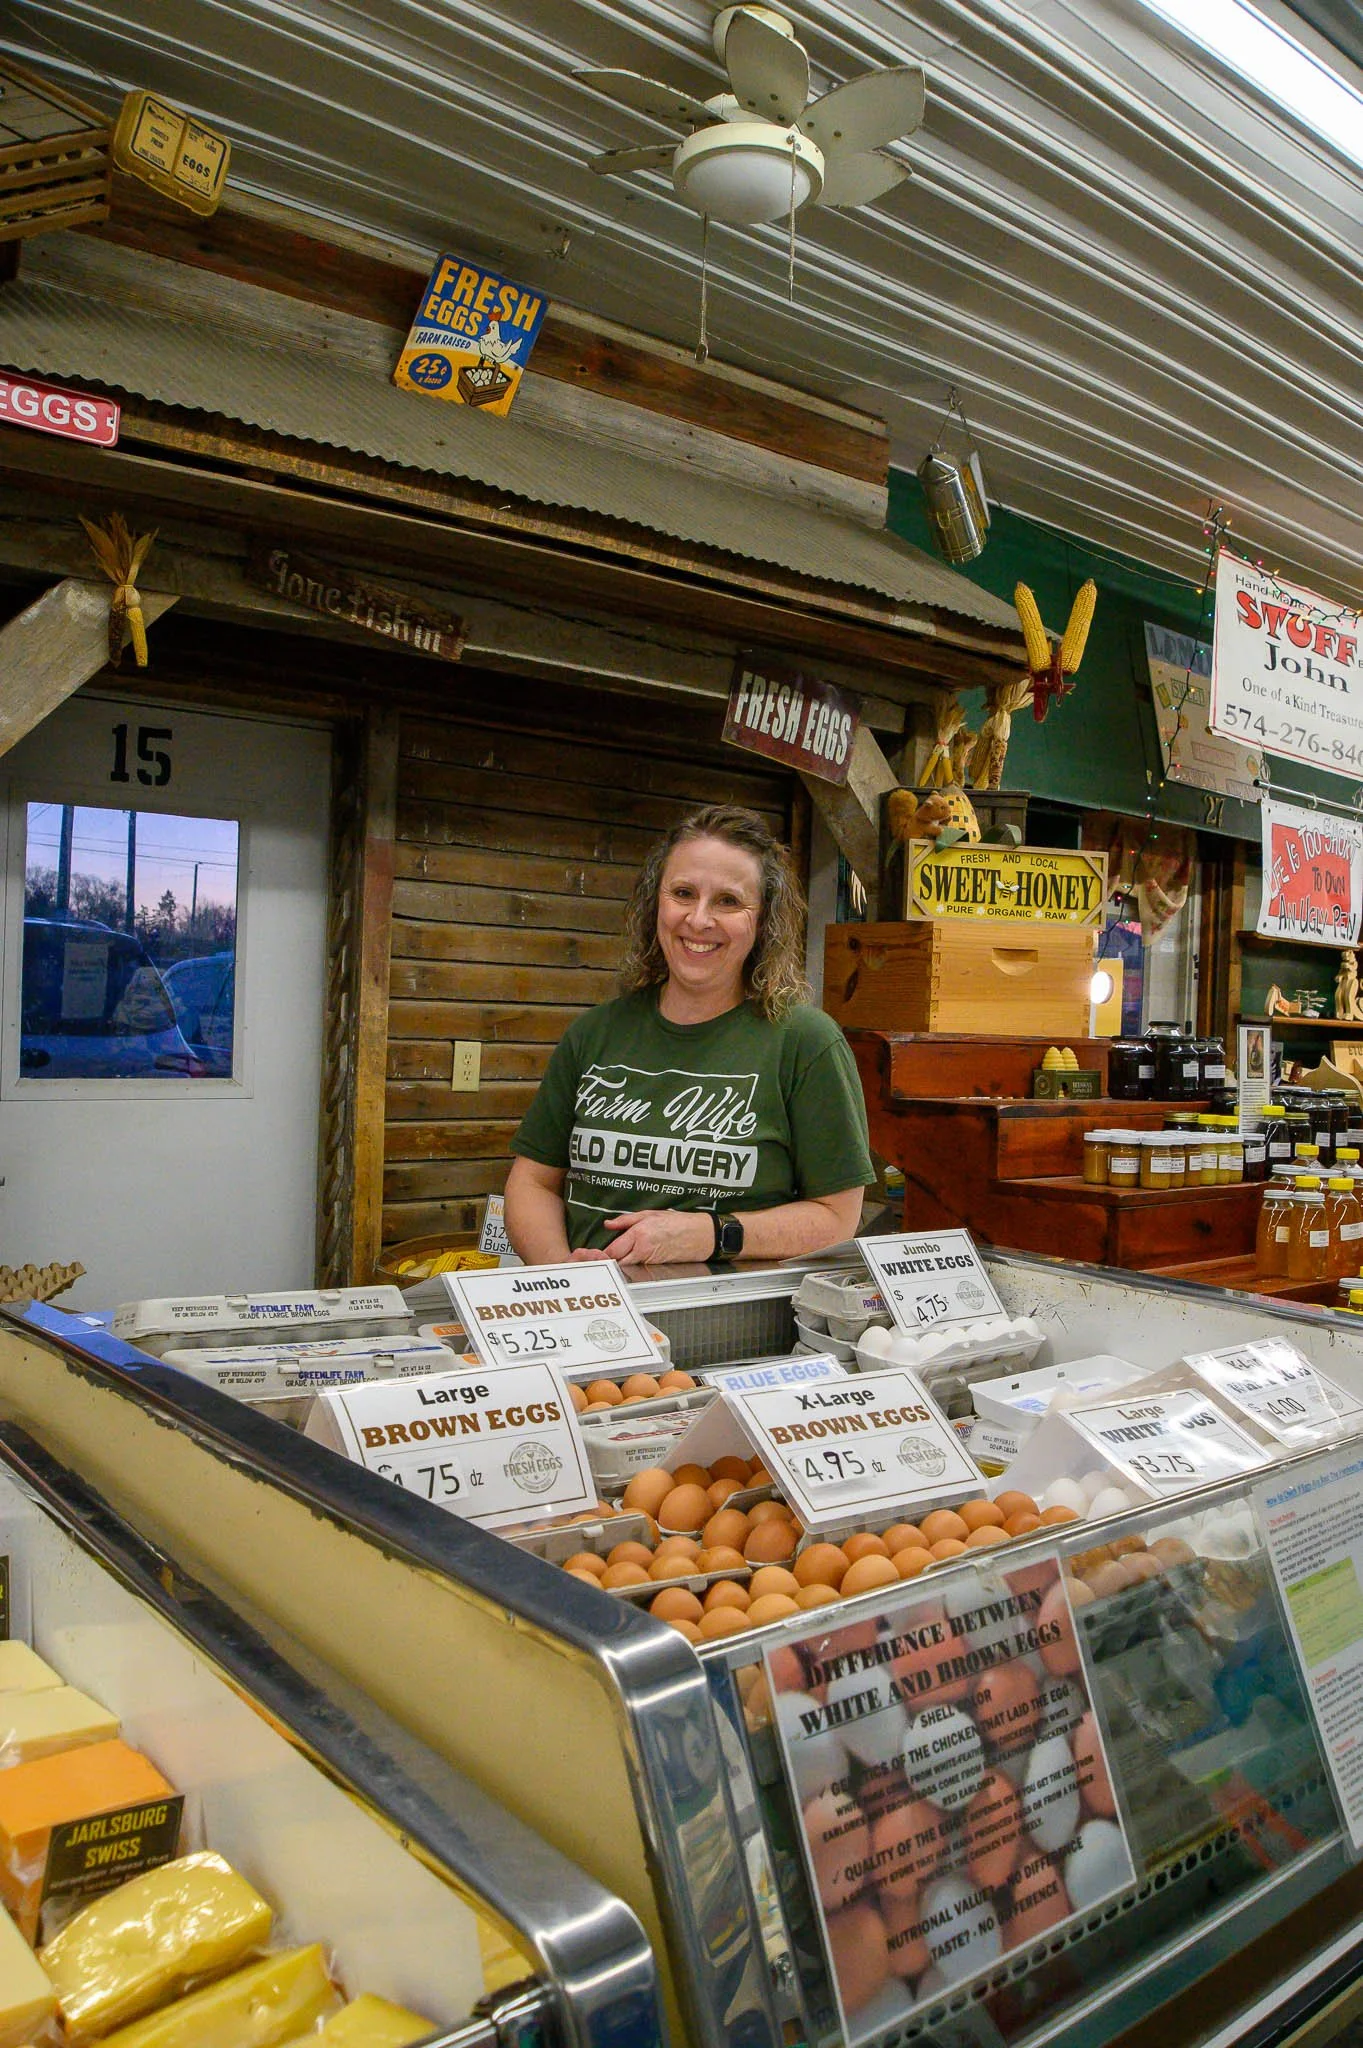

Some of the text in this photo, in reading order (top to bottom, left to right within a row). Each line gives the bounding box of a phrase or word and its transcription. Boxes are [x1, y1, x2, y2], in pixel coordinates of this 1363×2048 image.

[433, 258, 542, 331] FRESH
[424, 294, 483, 336] EGGS
[416, 331, 471, 350] FARM RAISED
[415, 357, 448, 376] 25¢
[1236, 590, 1358, 667] STUFF
[1264, 640, 1351, 694] John
[1242, 677, 1268, 697] One
[1270, 687, 1282, 701] of
[1292, 693, 1317, 715] Kind
[733, 670, 852, 765] FRESH EGGS
[110, 723, 173, 786] 15
[960, 853, 1059, 870] FRESH AND LOCAL
[1285, 839, 1300, 874] IS
[1297, 825, 1322, 861] TOO
[919, 863, 1096, 911] SWEET HONEY
[946, 905, 1068, 920] PURE ORGANIC RAW
[1278, 893, 1357, 941] AN UGLY PEN
[575, 1074, 757, 1143] Farm Wife
[613, 1139, 752, 1181] DELIVERY
[591, 1175, 633, 1190] FARMERS
[660, 1184, 685, 1195] FEED
[687, 1187, 707, 1196] THE
[484, 1238, 513, 1254] Bush
[903, 1242, 941, 1256] Jumbo
[880, 1254, 974, 1277] WHITE EGGS
[512, 1277, 571, 1294] Jumbo
[238, 1312, 260, 1320] GRADE
[268, 1311, 289, 1319] LARGE
[291, 1310, 312, 1318] BROWN
[313, 1309, 331, 1317] EGGS
[250, 1303, 315, 1313] GREENLIFE FARM
[475, 1292, 622, 1321] BROWN EGGS
[559, 1336, 573, 1348] dz
[285, 1380, 308, 1388] GRADE
[316, 1379, 338, 1387] LARGE
[299, 1370, 365, 1380] GREENLIFE FARM
[724, 1360, 831, 1391] BLUE EGGS
[416, 1384, 490, 1407] Large
[794, 1389, 876, 1411] X-Large
[360, 1401, 561, 1449] BROWN EGGS
[768, 1403, 931, 1446] BROWN EGGS
[1117, 1404, 1166, 1421] Large
[502, 1456, 563, 1479] FRESH EGGS
[872, 1458, 886, 1474] dz
[897, 1447, 946, 1465] FRESH EGGS
[470, 1469, 485, 1487] dz
[802, 1587, 1044, 1690] DIFFERENCE BETWEEN
[797, 1617, 1062, 1736] WHITE AND BROWN EGGS
[890, 1753, 906, 1771] OF
[907, 1743, 930, 1764] THE
[930, 1723, 978, 1755] CHICKEN
[978, 1711, 1007, 1734] THAT
[1005, 1701, 1031, 1722] LAID
[1029, 1692, 1049, 1711] THE
[1049, 1683, 1070, 1703] EGG
[918, 1702, 955, 1729] SHELL
[65, 1804, 169, 1848] JARLSBURG
[842, 1844, 896, 1884] QUALITY
[895, 1835, 914, 1857] OF
[913, 1825, 937, 1849] THE
[1035, 1774, 1049, 1789] GET
[84, 1837, 141, 1869] SWISS
[884, 1905, 954, 1954] NUTRIONAL
[929, 1927, 972, 1963] TASTE?
[977, 1914, 996, 1936] NO
